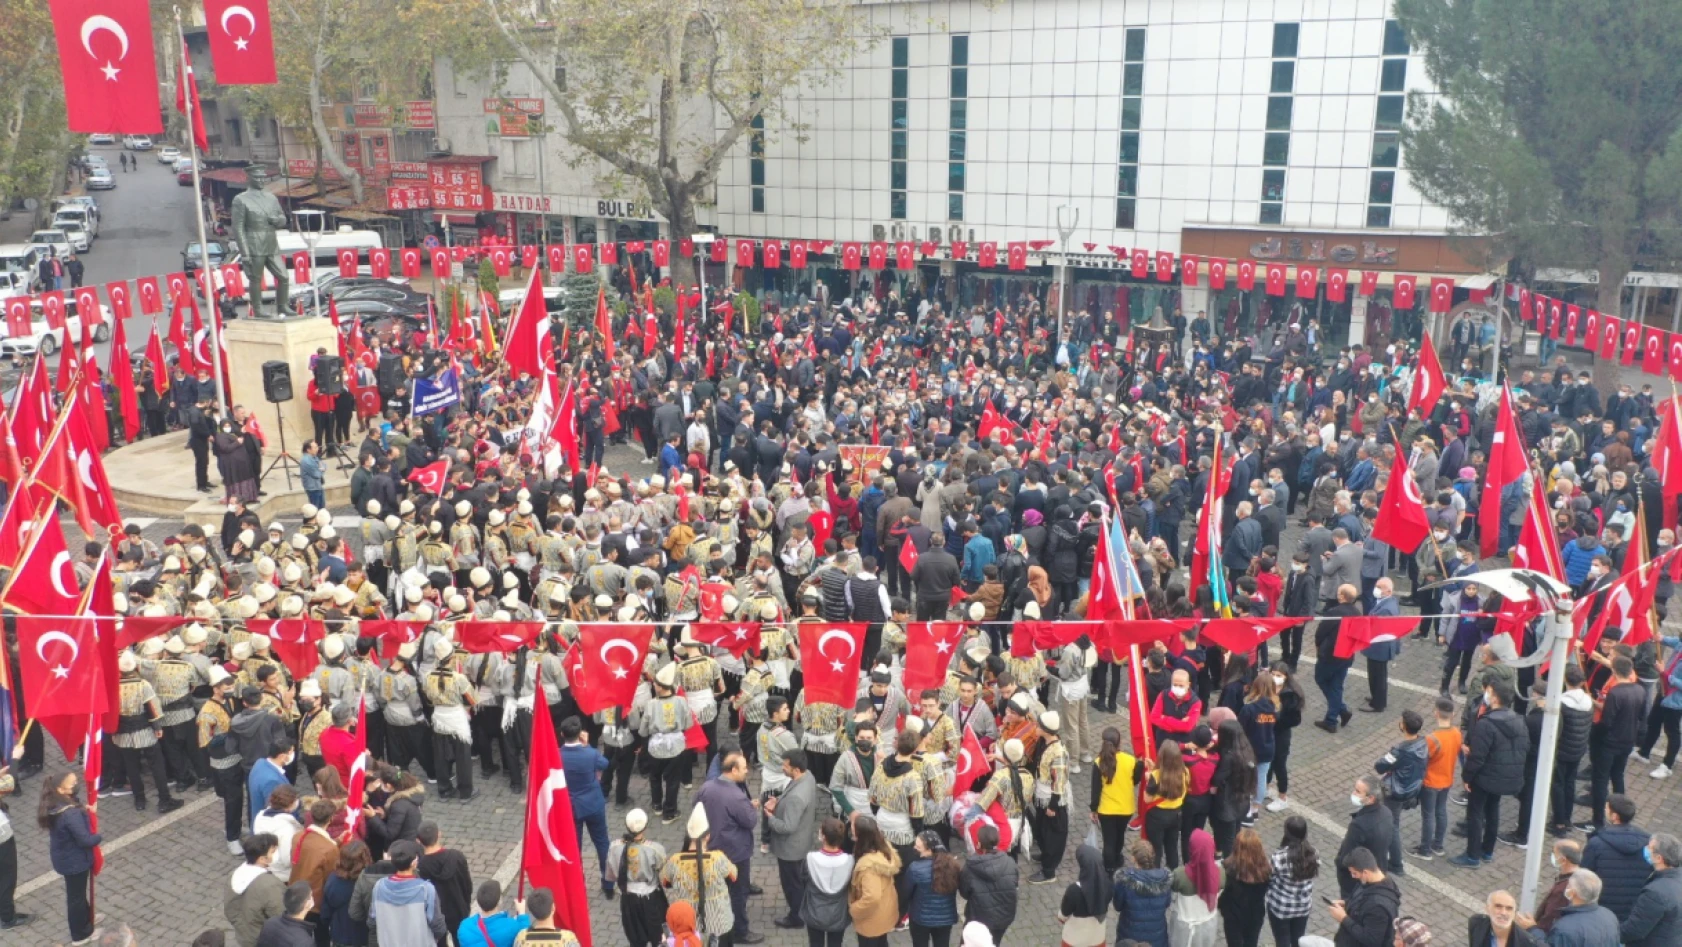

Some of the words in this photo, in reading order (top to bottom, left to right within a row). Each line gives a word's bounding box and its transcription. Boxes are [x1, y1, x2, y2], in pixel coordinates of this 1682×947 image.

[470, 194, 482, 206] 70
[500, 195, 551, 212] HAYDAR
[1249, 236, 1397, 265] dilek
